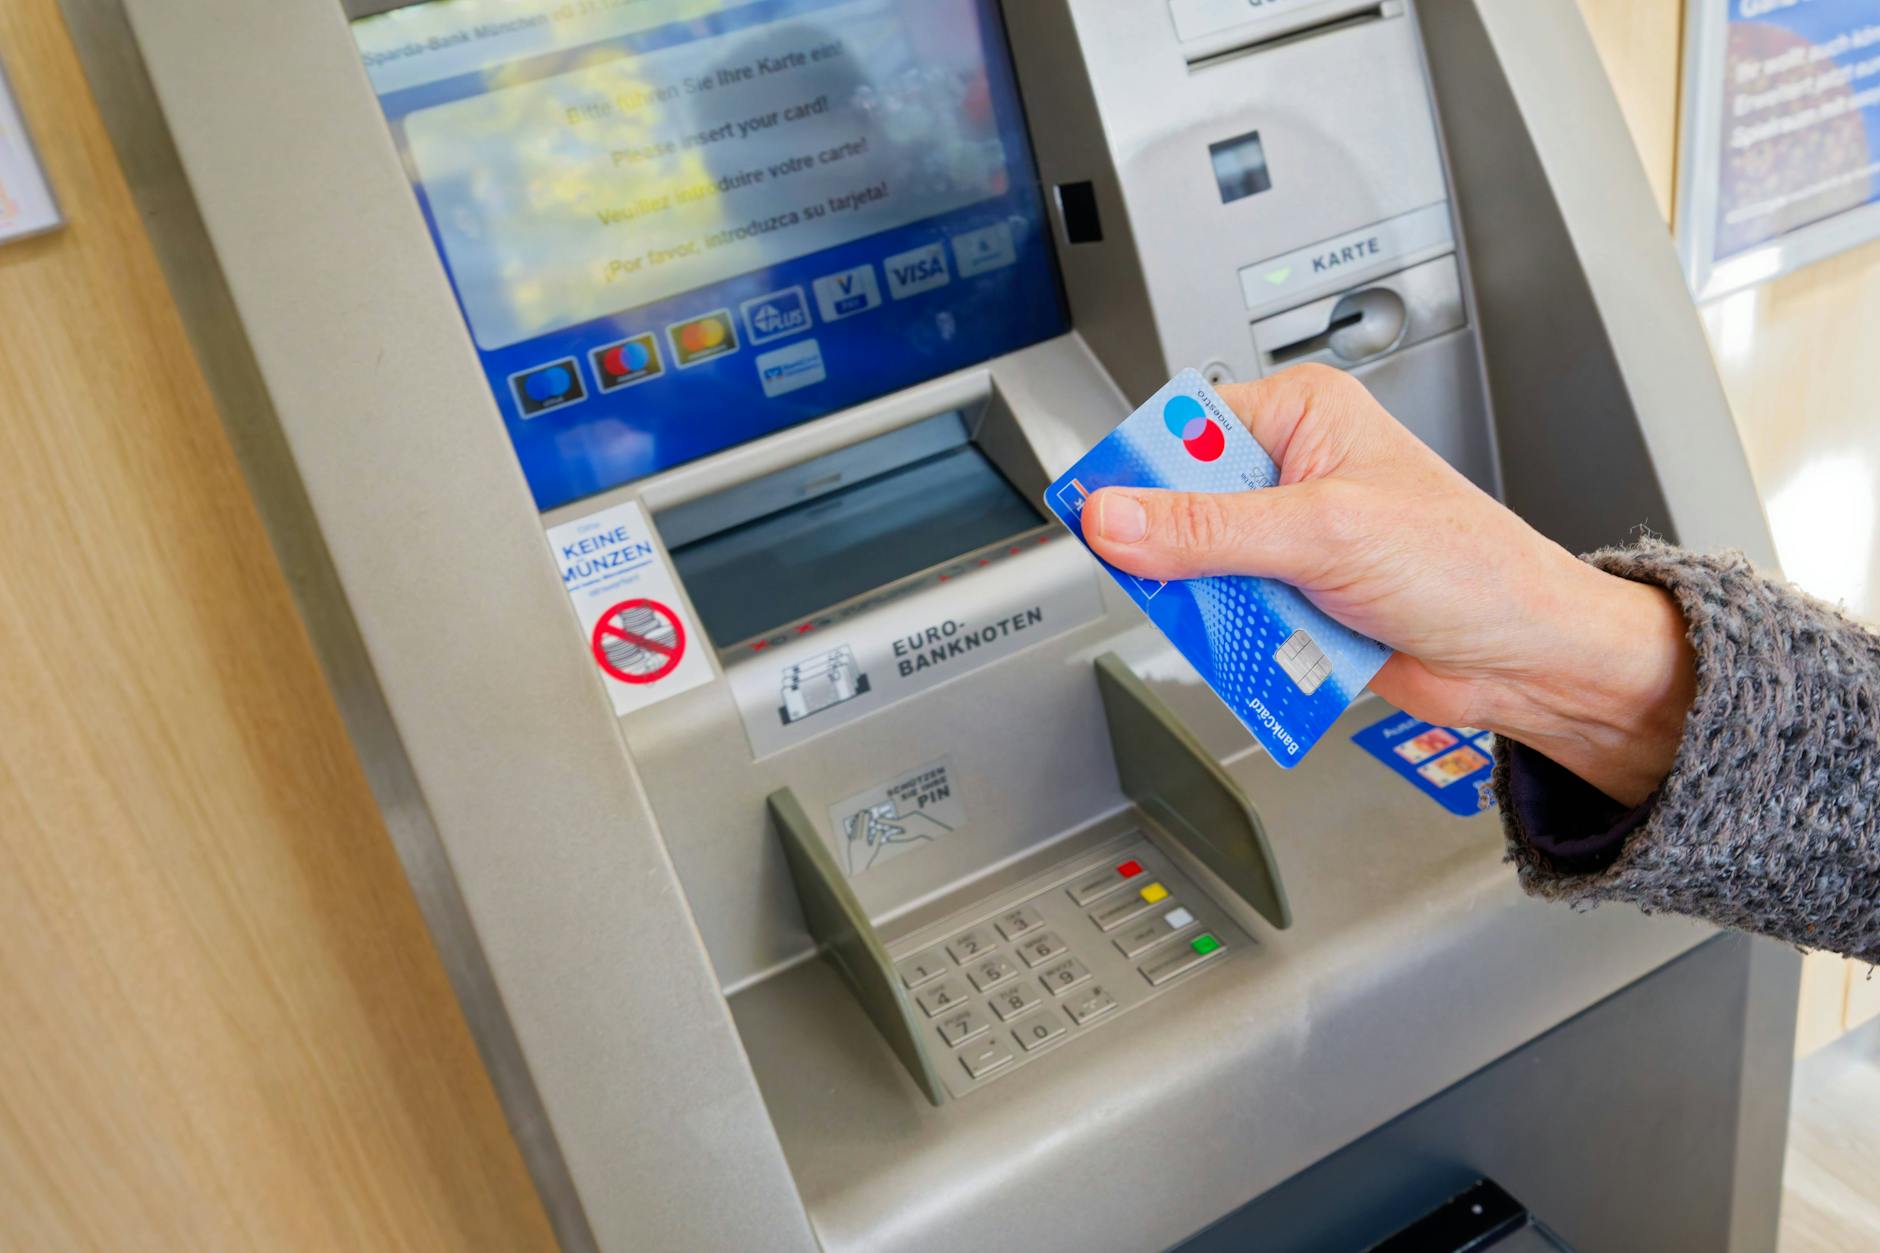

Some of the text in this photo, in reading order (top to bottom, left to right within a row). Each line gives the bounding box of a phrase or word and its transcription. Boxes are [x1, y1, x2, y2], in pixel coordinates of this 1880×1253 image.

[683, 74, 714, 96] Sie
[716, 66, 754, 87] Ihre
[755, 53, 806, 77] Karte
[611, 95, 830, 167] Please insert your card!
[597, 137, 869, 226] Veuillez introduire votre carte!
[704, 209, 801, 249] introduzca
[802, 203, 827, 222] su
[828, 181, 889, 216] tarjeta!
[1312, 237, 1381, 273] KARTE
[893, 256, 945, 286] VISA
[1197, 390, 1233, 431] maestro
[562, 526, 631, 559] KEINE
[562, 540, 653, 582] MÜNZEN
[893, 619, 967, 657] EURO-
[898, 607, 1044, 677] BANKNOTEN
[1249, 698, 1300, 756] BankCard
[917, 784, 950, 809] PIN
[1013, 918, 1028, 931] 3
[965, 941, 978, 954] 2
[1036, 943, 1050, 956] 6
[916, 965, 928, 977] 1
[986, 968, 1001, 981] 5
[1059, 971, 1074, 984] 9
[937, 992, 950, 1005] 4
[1008, 995, 1024, 1009] 8
[955, 1020, 968, 1035] 7
